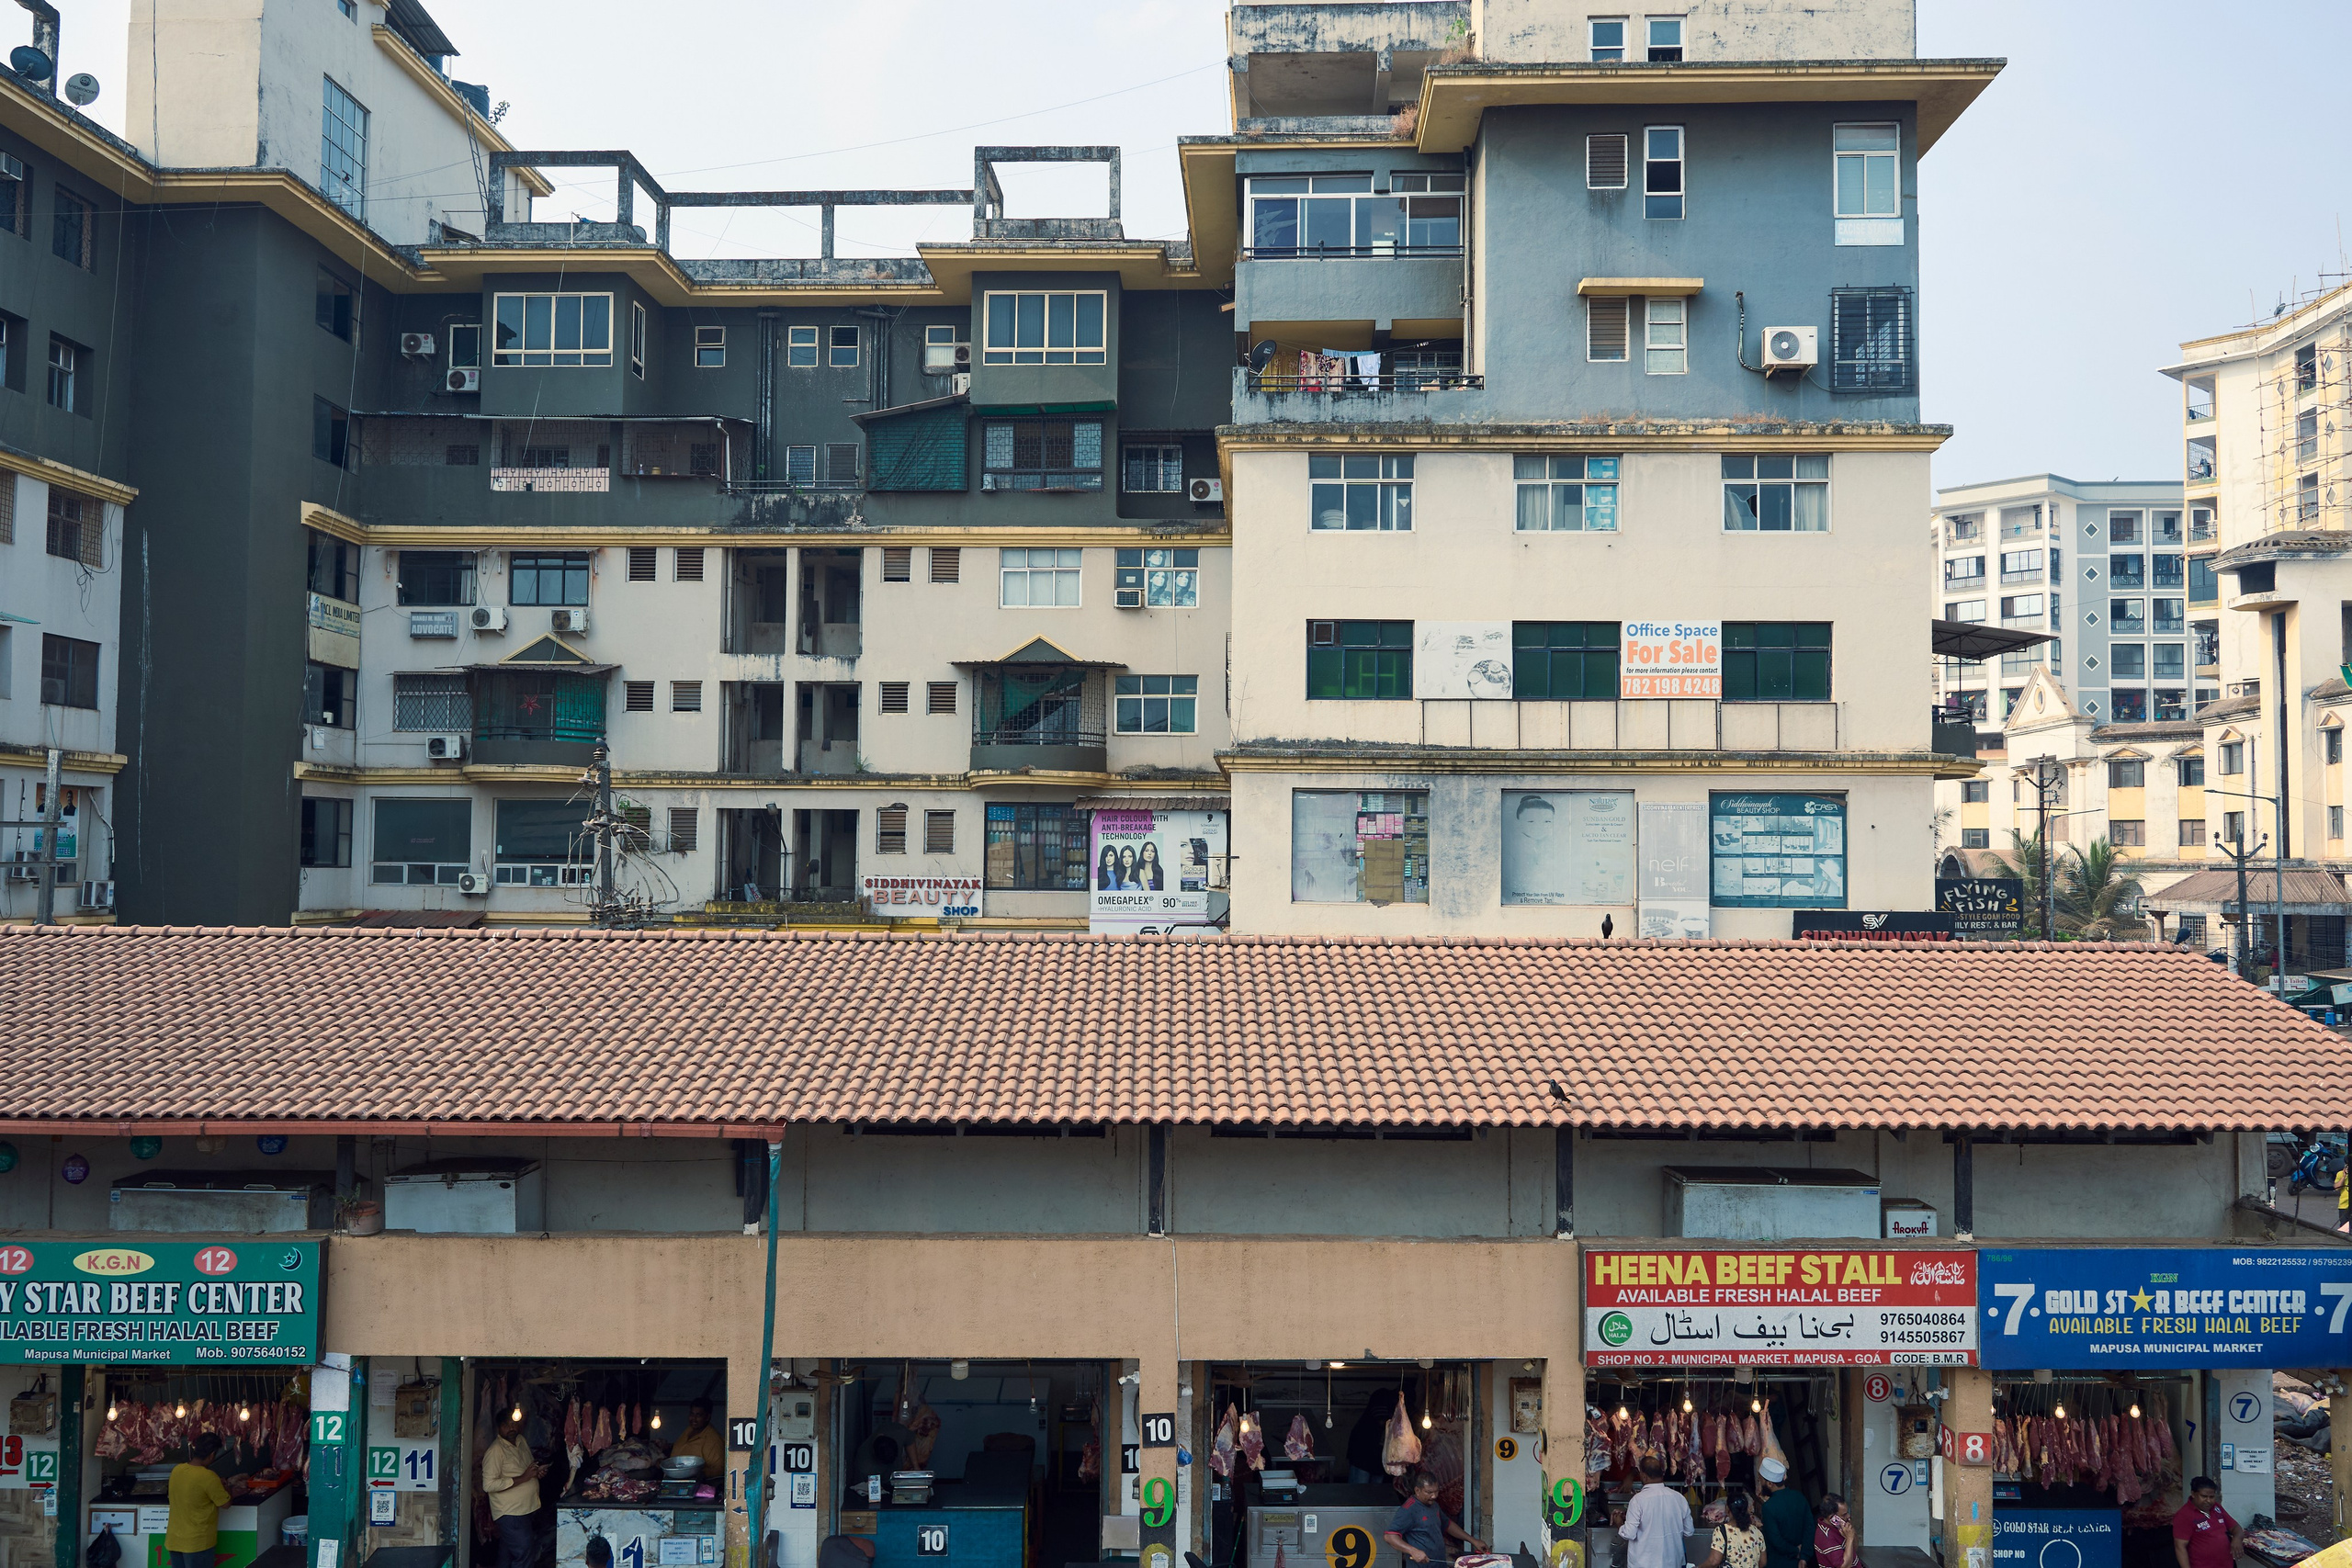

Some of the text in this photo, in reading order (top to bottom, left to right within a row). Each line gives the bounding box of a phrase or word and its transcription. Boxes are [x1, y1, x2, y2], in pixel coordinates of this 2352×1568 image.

[411, 625, 453, 634] ADVOCATE
[1626, 624, 1718, 640] Office Space
[1627, 639, 1717, 664] For Sale
[1681, 667, 1699, 675] please
[1624, 678, 1720, 694] 782 198 4248
[1102, 832, 1147, 840] TECHNOLOGY
[865, 878, 982, 889] SIDDHIVINAYAK
[873, 889, 975, 905] BEAUTY
[943, 906, 978, 916] SHOP
[1893, 1221, 1928, 1234] AROKYA
[0, 1250, 27, 1271] 12
[87, 1255, 141, 1269] K.G.N
[201, 1250, 230, 1271] 12
[2233, 1258, 2256, 1266] MOB:
[2256, 1258, 2307, 1266] 9822125532
[1595, 1255, 1902, 1285] HEENA BEEF STALL
[2150, 1273, 2178, 1282] KGN
[24, 1280, 102, 1315] STAR
[108, 1280, 182, 1315] BEEF
[187, 1280, 305, 1315] CENTER
[1616, 1288, 1882, 1303] AVAILABLE FRESH HALAL BEEF
[2045, 1290, 2098, 1314] GOLD
[2175, 1290, 2224, 1314] BEEF
[2228, 1290, 2306, 1314] CENTER
[1880, 1313, 1965, 1326] 9765040864
[2142, 1316, 2197, 1334] FRESH
[2204, 1316, 2252, 1334] HALAL
[2260, 1316, 2302, 1334] BEEF
[73, 1320, 143, 1342] FRESH
[148, 1320, 222, 1342] HALAL
[225, 1320, 279, 1342] BEEF
[1880, 1330, 1965, 1344] 9145505867
[25, 1348, 171, 1361] Mapusa Municipal Market
[196, 1347, 306, 1359] Mob. 9075640152
[2090, 1343, 2263, 1353] MAPUSA MUNICIPAL MARKET
[1597, 1355, 1631, 1365] SHOP
[1634, 1355, 1655, 1365] NO.
[1671, 1354, 1736, 1365] MUNICIPAL
[1738, 1354, 1791, 1365] MARKET,
[1793, 1354, 1845, 1364] MAPUSA
[1894, 1354, 1965, 1364] CODE: B.M.R
[1871, 1380, 1884, 1398] 8
[2236, 1398, 2253, 1419] 7
[316, 1416, 343, 1440] 12
[733, 1423, 757, 1446] 10
[1146, 1418, 1171, 1442] 10
[1498, 1438, 1516, 1459] 9
[1944, 1428, 1952, 1458] 8
[1966, 1435, 1984, 1462] 8
[30, 1455, 53, 1477] 12
[372, 1449, 434, 1481] 12 11
[787, 1448, 810, 1469] 10
[1886, 1471, 1904, 1491] 7
[1143, 1477, 1175, 1528] 9
[1553, 1477, 1584, 1527] 9
[2004, 1521, 2026, 1533] GOLD
[2028, 1521, 2049, 1534] STAR
[922, 1529, 944, 1551] 10
[1332, 1528, 1371, 1568] 9
[1993, 1550, 2025, 1559] SHOP NO
